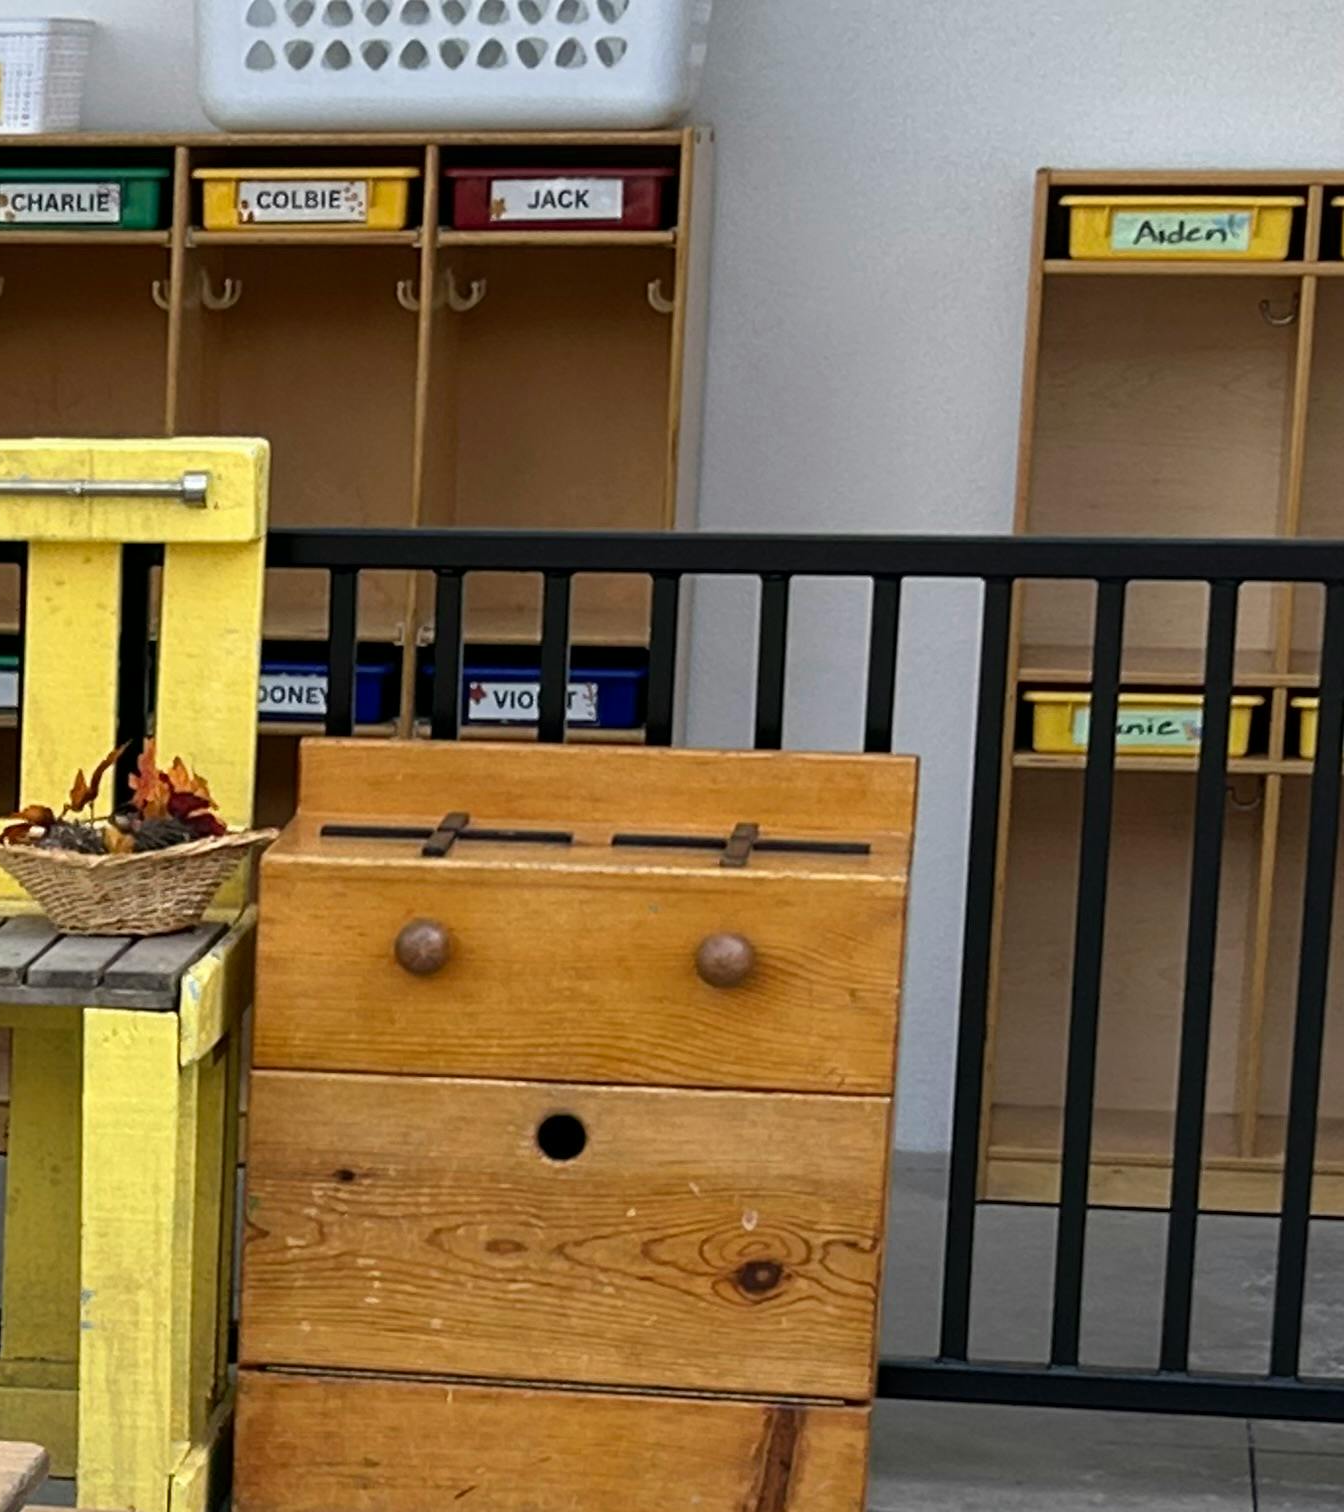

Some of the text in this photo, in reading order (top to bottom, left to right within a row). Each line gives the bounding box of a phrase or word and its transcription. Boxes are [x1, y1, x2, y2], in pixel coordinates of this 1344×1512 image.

[11, 192, 111, 213] CHARLIE
[255, 189, 343, 210] COLBIE
[527, 188, 591, 210] JACK
[1132, 219, 1228, 246] Aiden
[493, 689, 577, 710] VIOT
